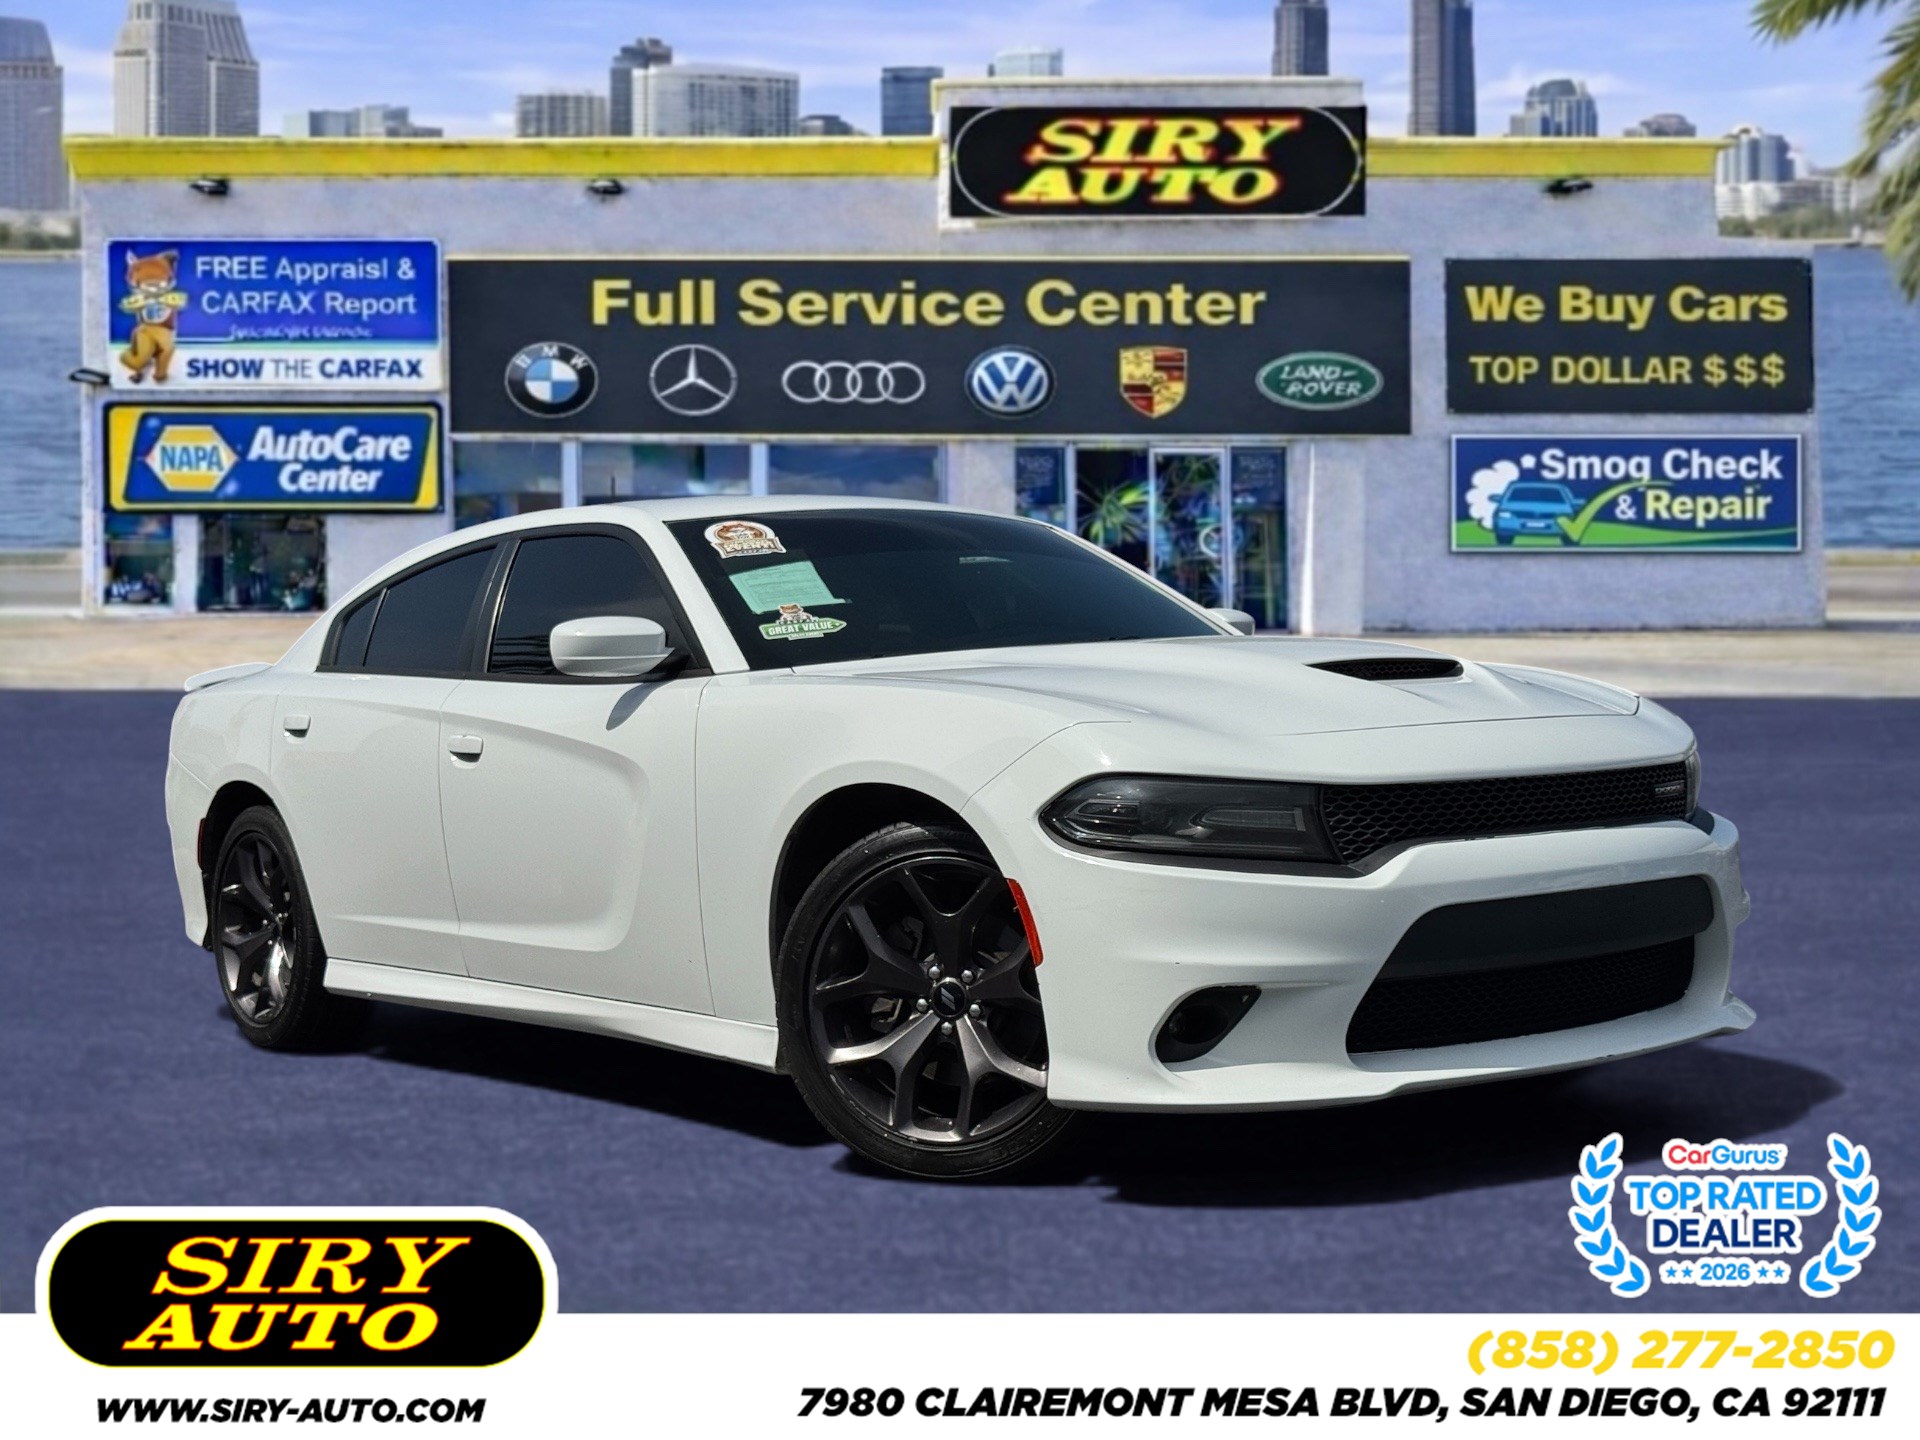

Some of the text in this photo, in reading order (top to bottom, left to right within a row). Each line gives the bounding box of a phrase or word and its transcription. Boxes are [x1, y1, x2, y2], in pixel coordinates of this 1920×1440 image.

[1024, 117, 1302, 163] SIRY
[1003, 167, 1281, 203] AUTO
[196, 256, 416, 284] FREE Appraisl &
[201, 291, 417, 319] CARFAX Report
[592, 279, 1267, 325] Full Service Center
[1465, 285, 1788, 330] We Buy Cars
[187, 358, 423, 378] SHOW THE CARFAX
[1469, 356, 1539, 384] TOP
[1551, 356, 1692, 384] DOLLAR
[159, 446, 225, 472] NAPA
[247, 426, 412, 461] AutoCare
[278, 464, 382, 492] Center
[1540, 448, 1783, 491] Smog Check
[1615, 487, 1773, 526] & Repair
[768, 625, 800, 636] GREAT
[802, 621, 834, 631] VALUE
